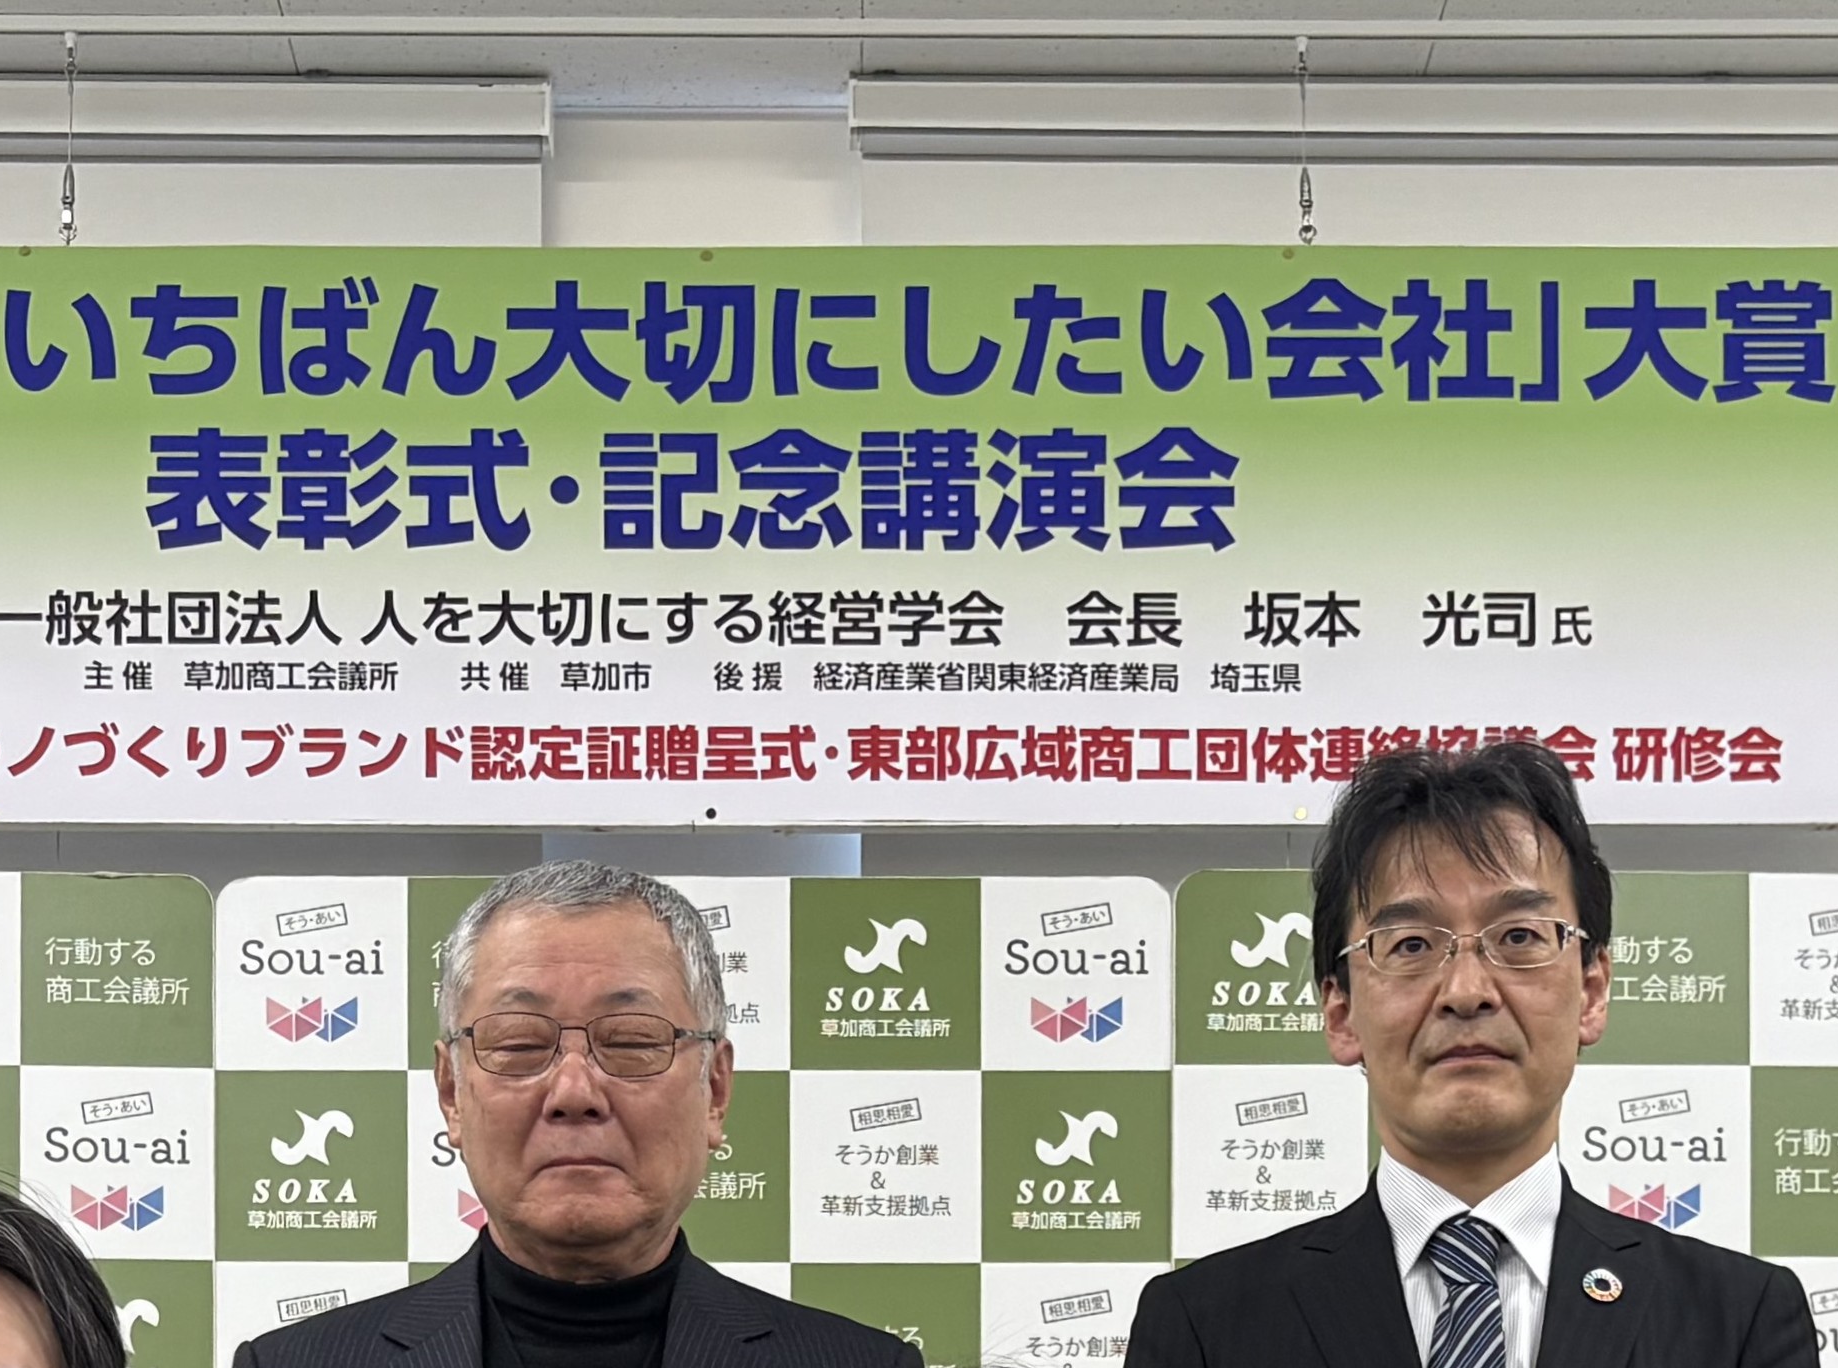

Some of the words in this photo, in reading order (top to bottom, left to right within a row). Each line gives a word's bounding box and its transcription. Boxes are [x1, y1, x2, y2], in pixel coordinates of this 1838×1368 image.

[146, 427, 1240, 551] 表彰式・記念講演会
[361, 590, 1004, 647] 人を大切にする経営学会
[1067, 591, 1182, 647] 会長
[1244, 591, 1360, 647] 坂本
[1423, 591, 1536, 647] 光司
[1552, 606, 1592, 645] 氏
[84, 661, 152, 690] 主催
[184, 661, 398, 691] 草加商工会議所
[461, 661, 529, 691] 共催
[561, 662, 651, 691] 草加市
[714, 662, 782, 691] 後援
[814, 662, 1178, 692] 経済産業省関東経済産業局
[1211, 663, 1301, 693] 埼玉県
[1612, 726, 1783, 783] 研修会
[45, 937, 155, 965] 行動する
[240, 940, 384, 975] Sou-ai
[1005, 939, 1148, 975] Sou-ai
[46, 975, 189, 1005] 商工会議所
[826, 987, 930, 1011] SOKA
[1212, 981, 1317, 1006] SOKA
[821, 1018, 950, 1037] 草加商工会議所
[45, 1127, 190, 1164] Sou-ai
[836, 1144, 939, 1165] そうか創業
[1221, 1139, 1324, 1160] そうか創業
[1583, 1126, 1726, 1162] Sou-ai
[871, 1171, 885, 1189] &
[1256, 1165, 1271, 1184] &
[253, 1178, 357, 1203] SOKA
[1017, 1179, 1121, 1204] SOKA
[1206, 1190, 1338, 1214] 革新支援拠点
[821, 1195, 951, 1216] 革新支援拠点
[248, 1210, 377, 1228] 草加商工会議所
[1012, 1211, 1141, 1229] 草加商工会議所
